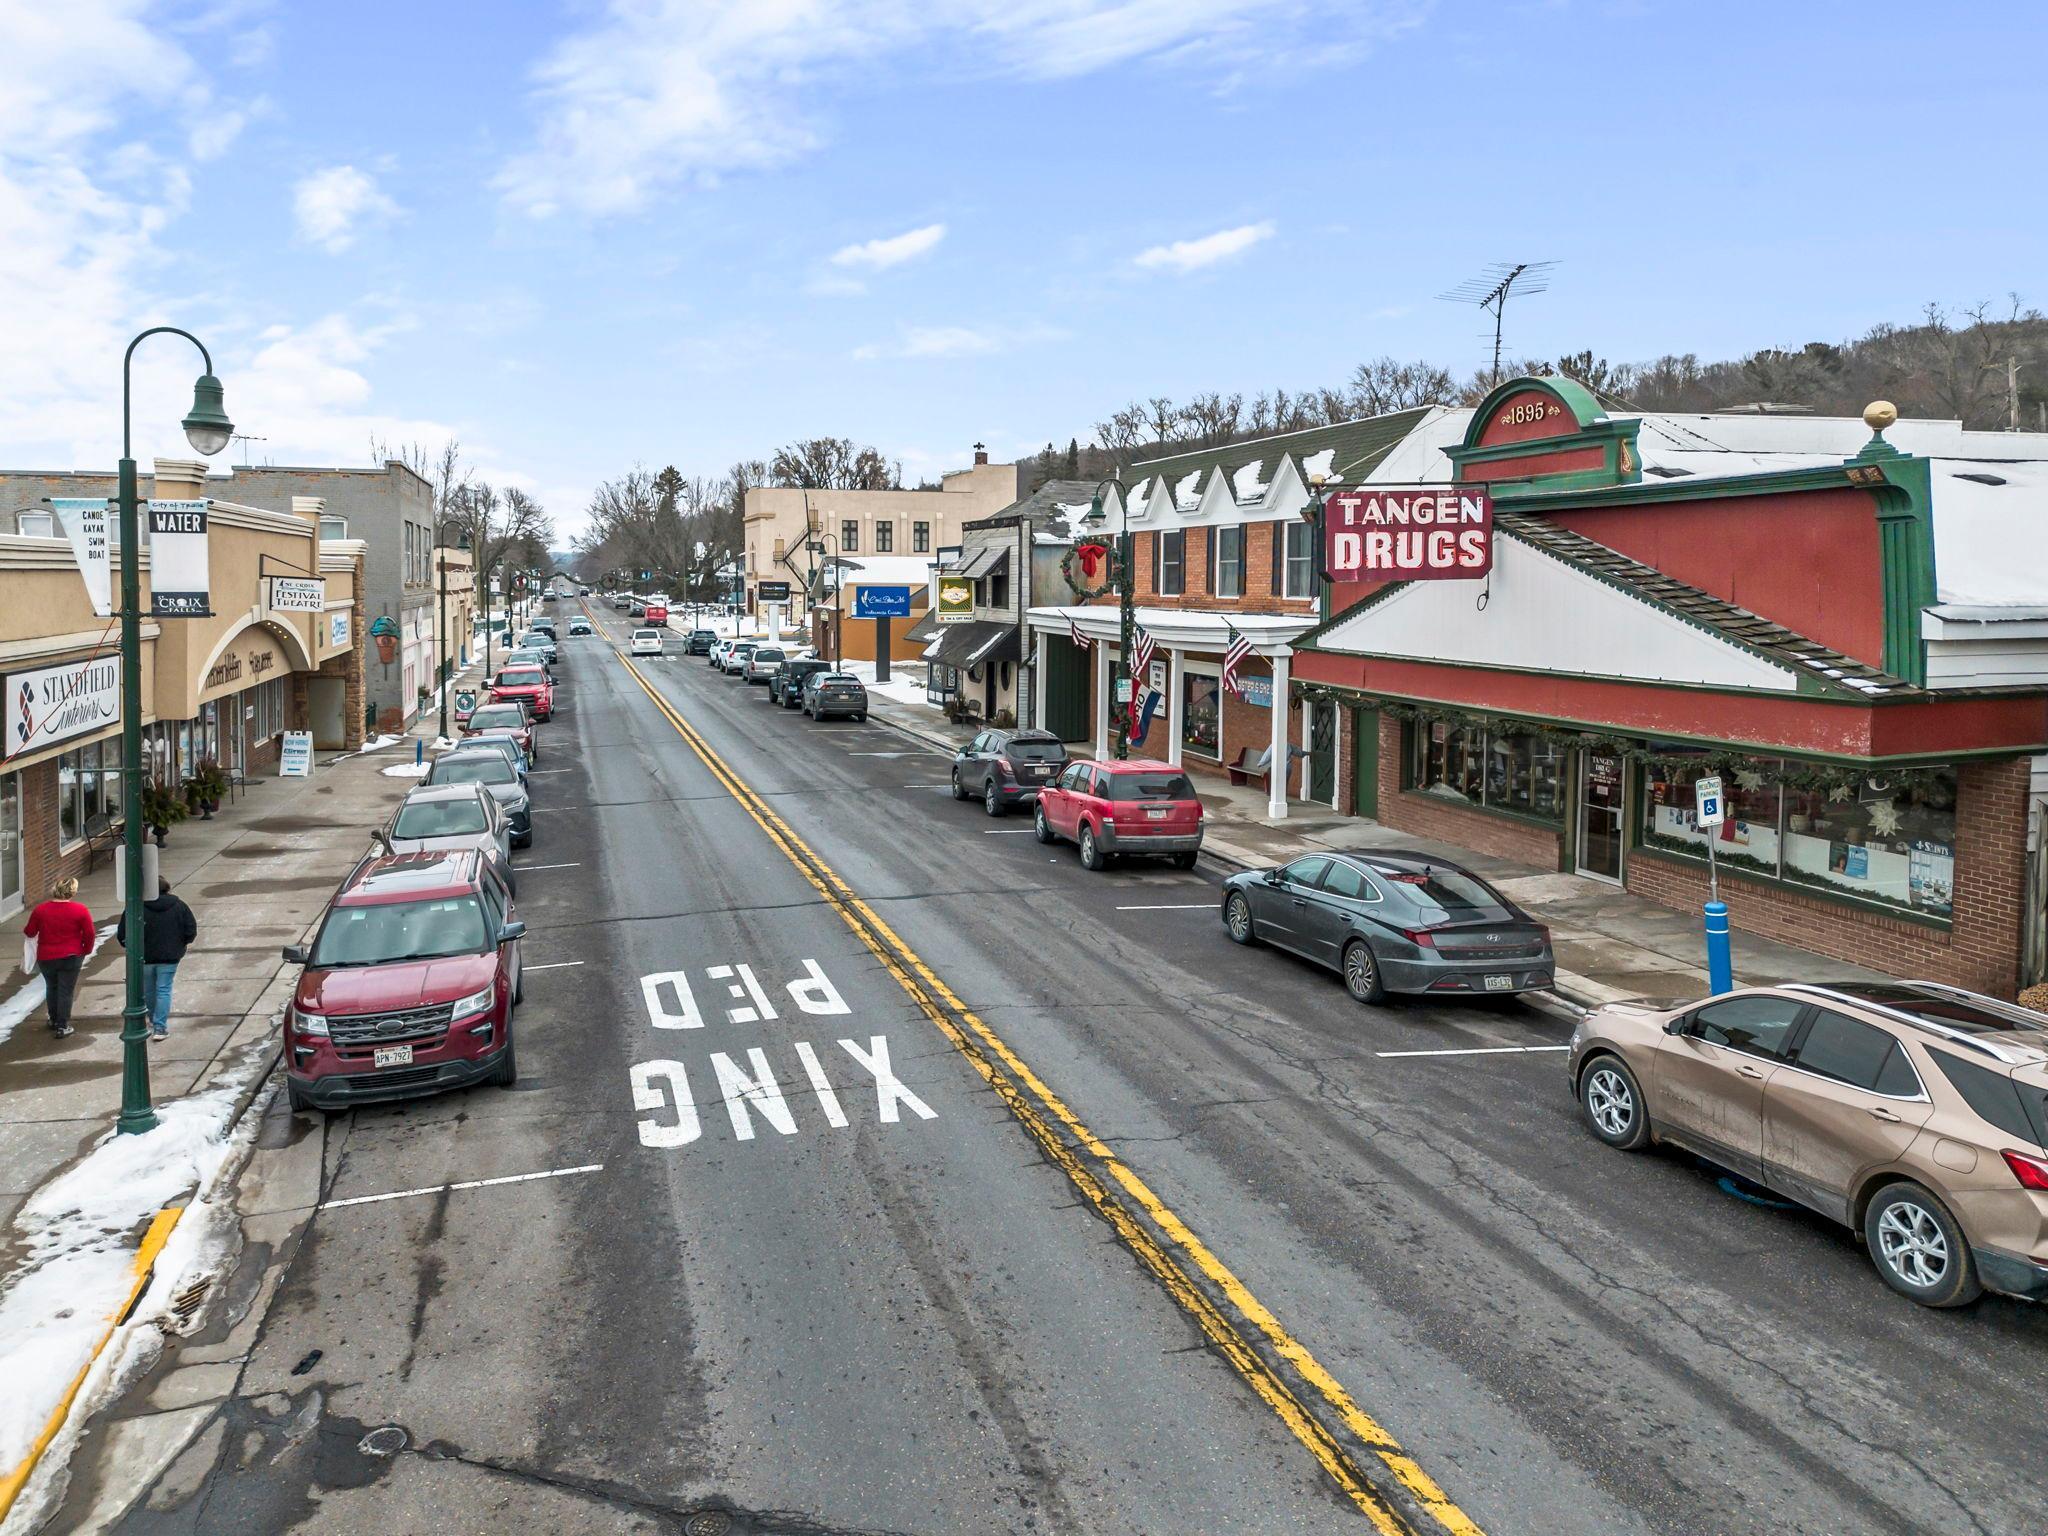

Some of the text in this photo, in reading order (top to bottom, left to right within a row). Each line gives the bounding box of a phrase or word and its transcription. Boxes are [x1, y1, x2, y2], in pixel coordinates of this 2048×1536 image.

[1510, 402, 1544, 424] 1895
[82, 510, 104, 520] CANOE
[1337, 496, 1483, 525] TANGEN
[83, 524, 104, 533] KAYAK
[156, 513, 200, 531] WATER
[88, 537, 105, 546] SWIM
[1334, 530, 1486, 570] DRUGS
[88, 550, 105, 559] BOAT
[275, 589, 321, 600] FESTIVAL
[275, 598, 323, 609] THEATRE
[43, 665, 115, 706] STANDFIELD
[640, 958, 852, 1030] PED
[629, 1035, 939, 1149] XING
